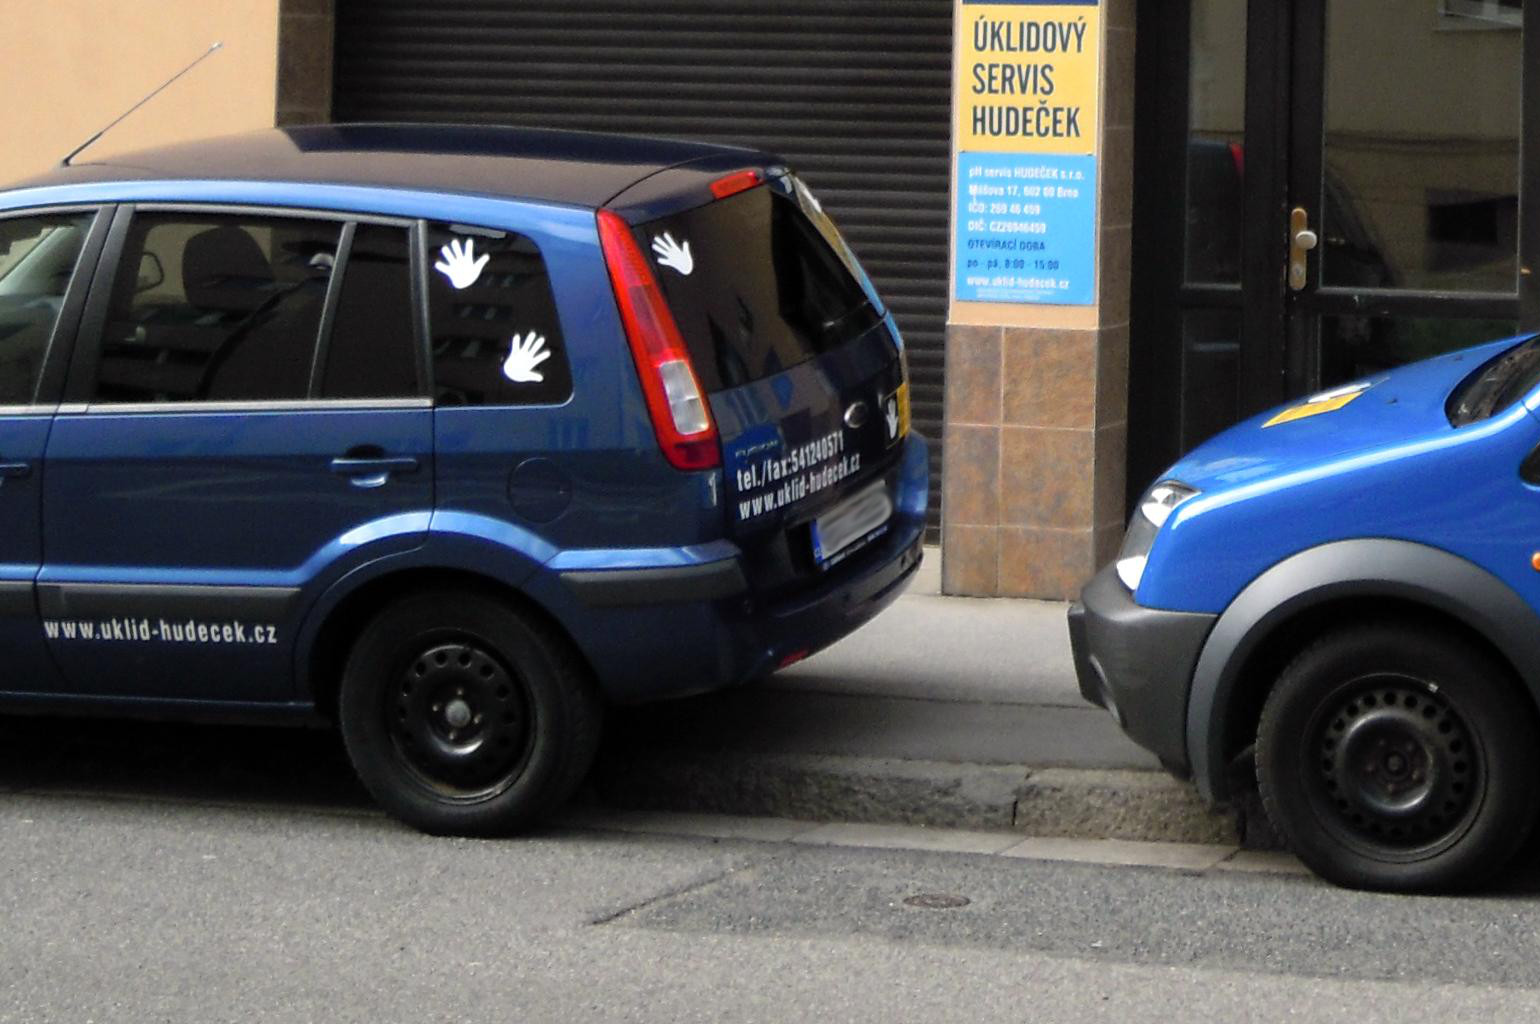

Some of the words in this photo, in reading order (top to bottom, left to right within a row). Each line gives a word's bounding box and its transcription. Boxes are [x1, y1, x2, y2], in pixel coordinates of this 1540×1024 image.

[973, 14, 1087, 53] ÚKLIDOVÝ
[972, 63, 1054, 95] SERVIS
[972, 99, 1080, 138] HUDEČEK
[968, 166, 982, 178] pH
[1014, 166, 1058, 179] HUDEČEK
[1057, 187, 1079, 198] Brno
[1019, 240, 1045, 252] DOBA
[739, 453, 861, 520] www.uklid-hudecek.cz
[44, 617, 278, 644] www.uklid-hudecek.cz
